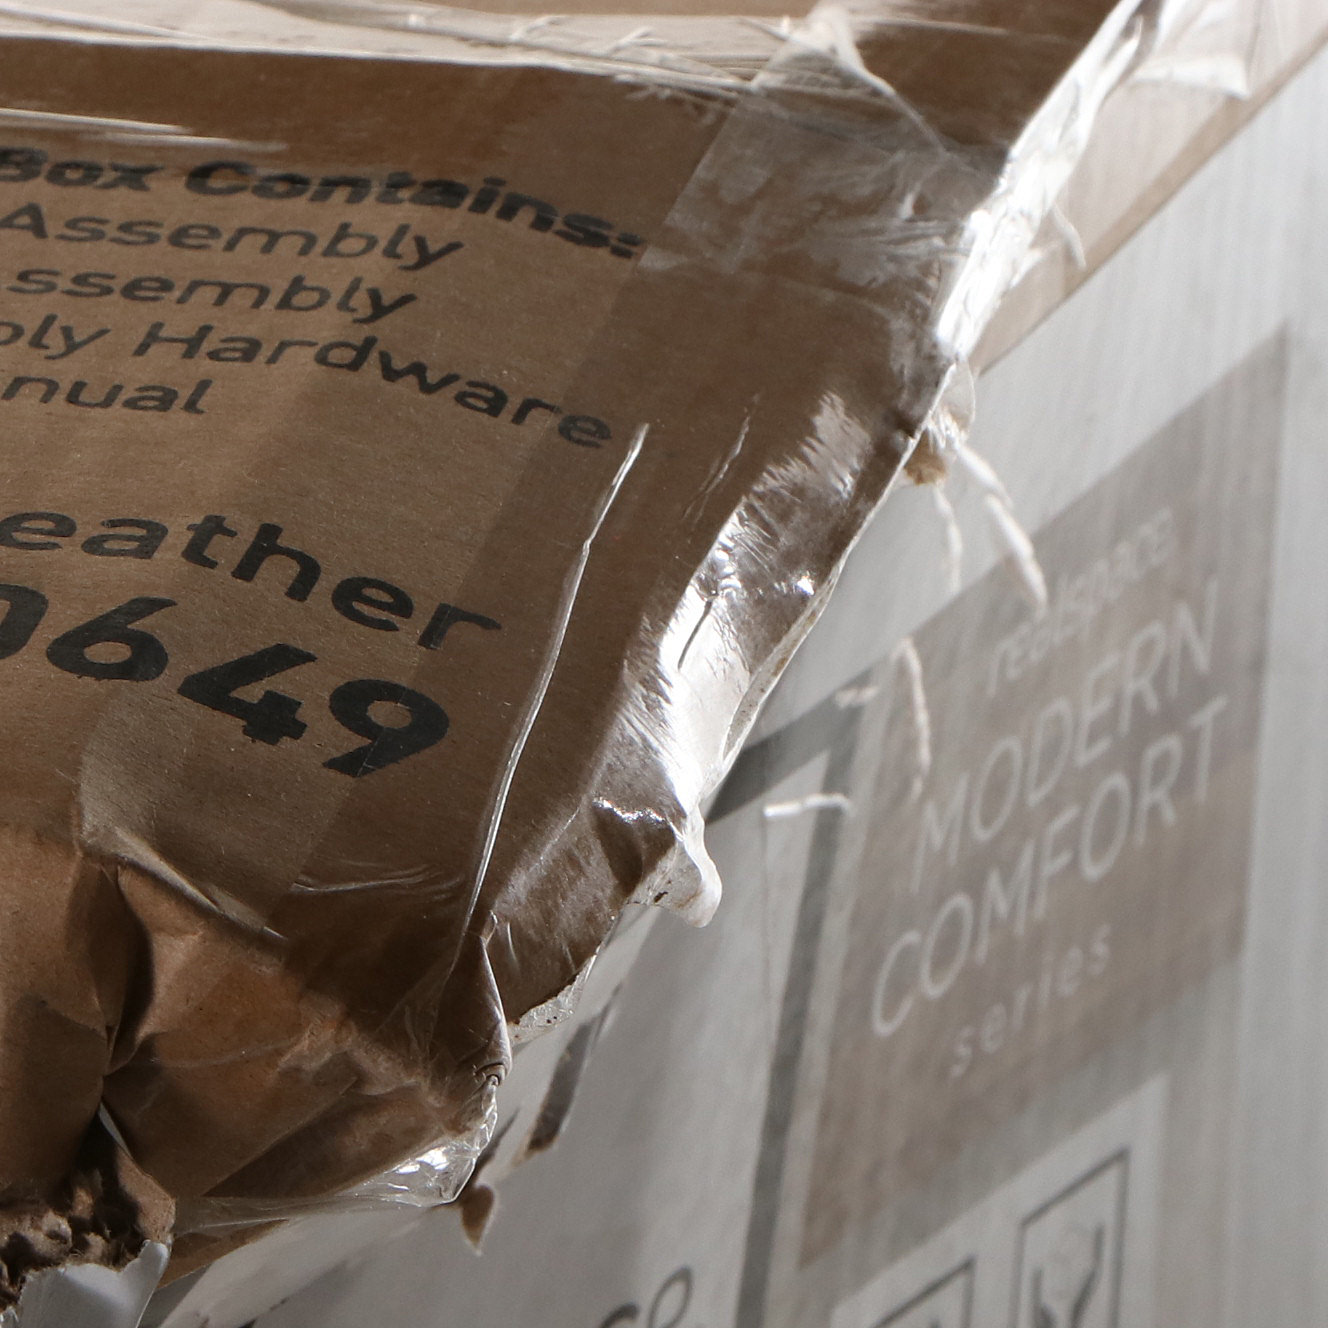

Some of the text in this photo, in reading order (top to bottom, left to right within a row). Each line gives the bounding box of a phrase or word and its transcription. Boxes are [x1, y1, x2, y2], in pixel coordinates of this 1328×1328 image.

[183, 160, 648, 260] Contains:
[131, 320, 613, 448] Hardware
[911, 580, 1219, 893] MODERN
[870, 696, 1229, 1037] COMFORT
[947, 924, 1112, 1079] series
